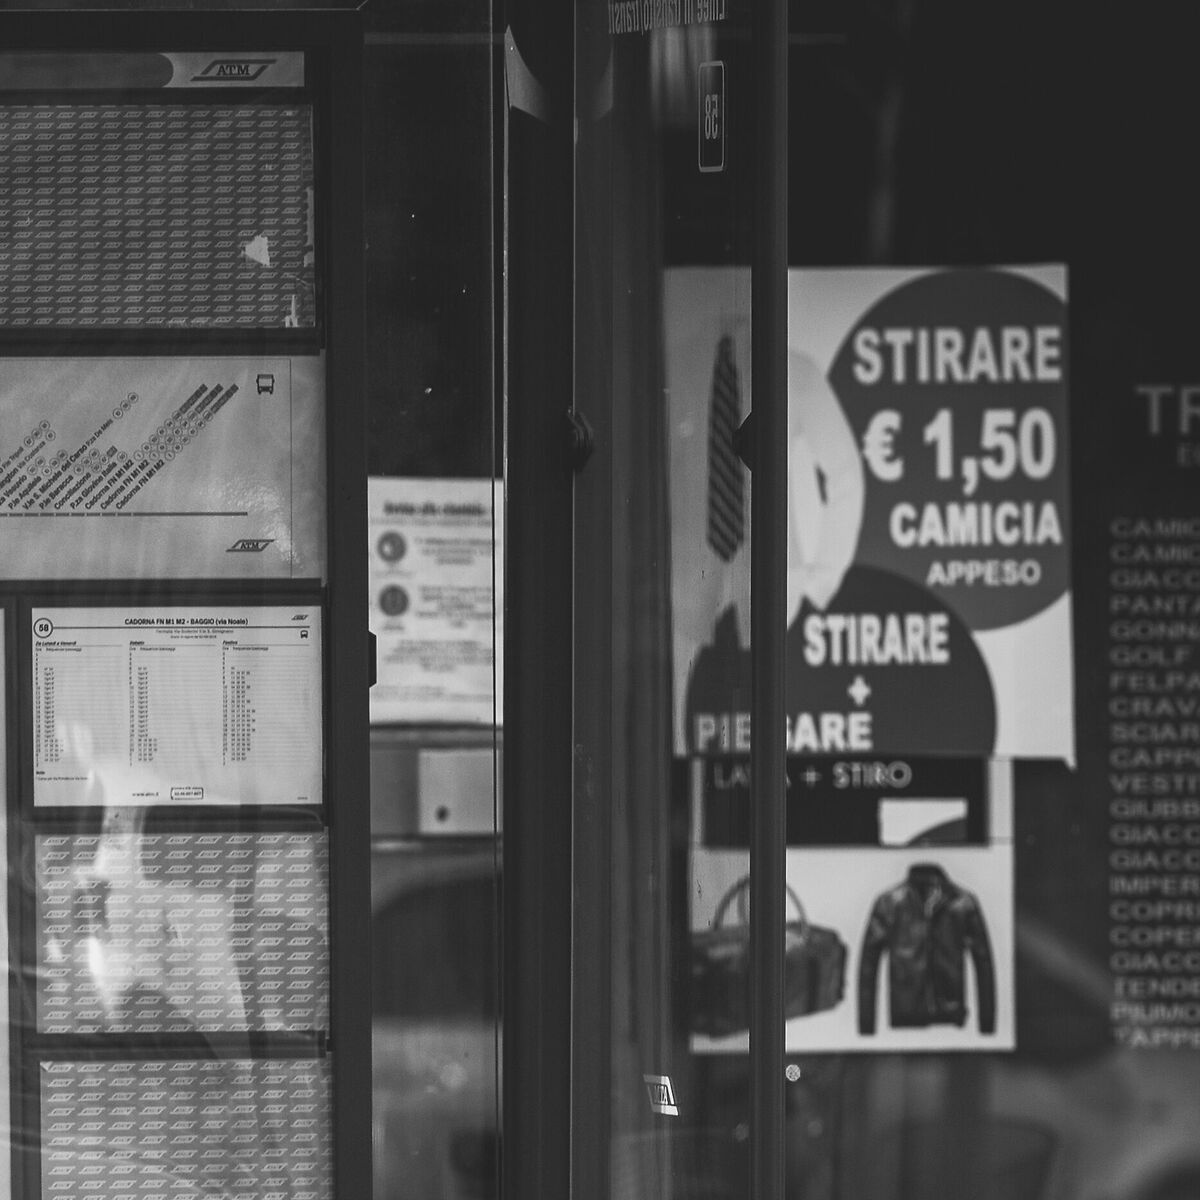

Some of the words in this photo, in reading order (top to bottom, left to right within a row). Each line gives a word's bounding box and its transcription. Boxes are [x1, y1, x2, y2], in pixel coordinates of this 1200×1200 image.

[216, 63, 251, 77] ATM
[852, 326, 1062, 384] STIRARE
[861, 409, 905, 482] €
[923, 407, 1057, 495] 1,50
[889, 501, 1062, 547] CAMICIA
[926, 559, 1042, 588] APPESO
[39, 624, 49, 633] 58
[803, 612, 951, 668] STIRARE
[692, 712, 874, 752] PIEARE
[831, 760, 913, 790] STIRO
